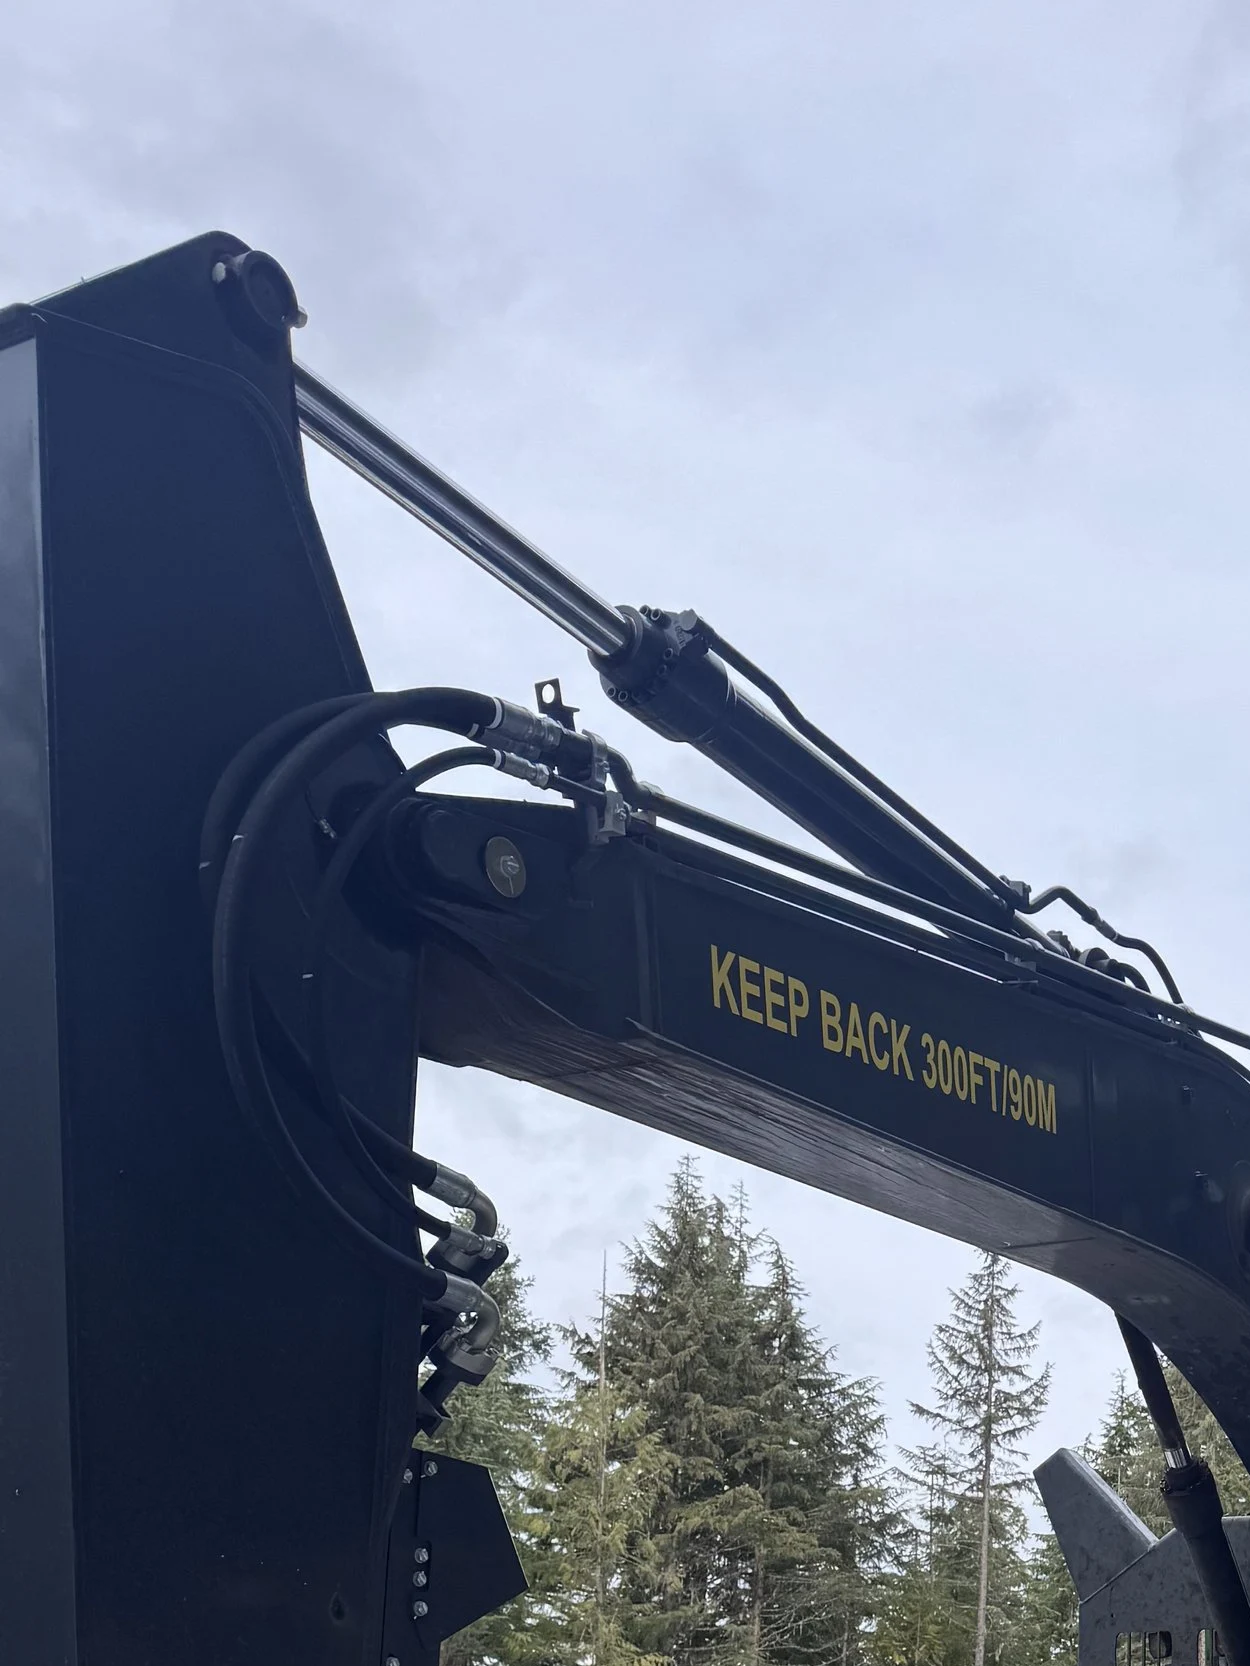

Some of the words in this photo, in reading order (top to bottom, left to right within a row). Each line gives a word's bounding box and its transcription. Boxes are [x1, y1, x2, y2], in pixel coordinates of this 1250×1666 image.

[710, 944, 810, 1037] KEEP
[819, 989, 914, 1082] BACK
[921, 1032, 1057, 1135] 300FT/90M
